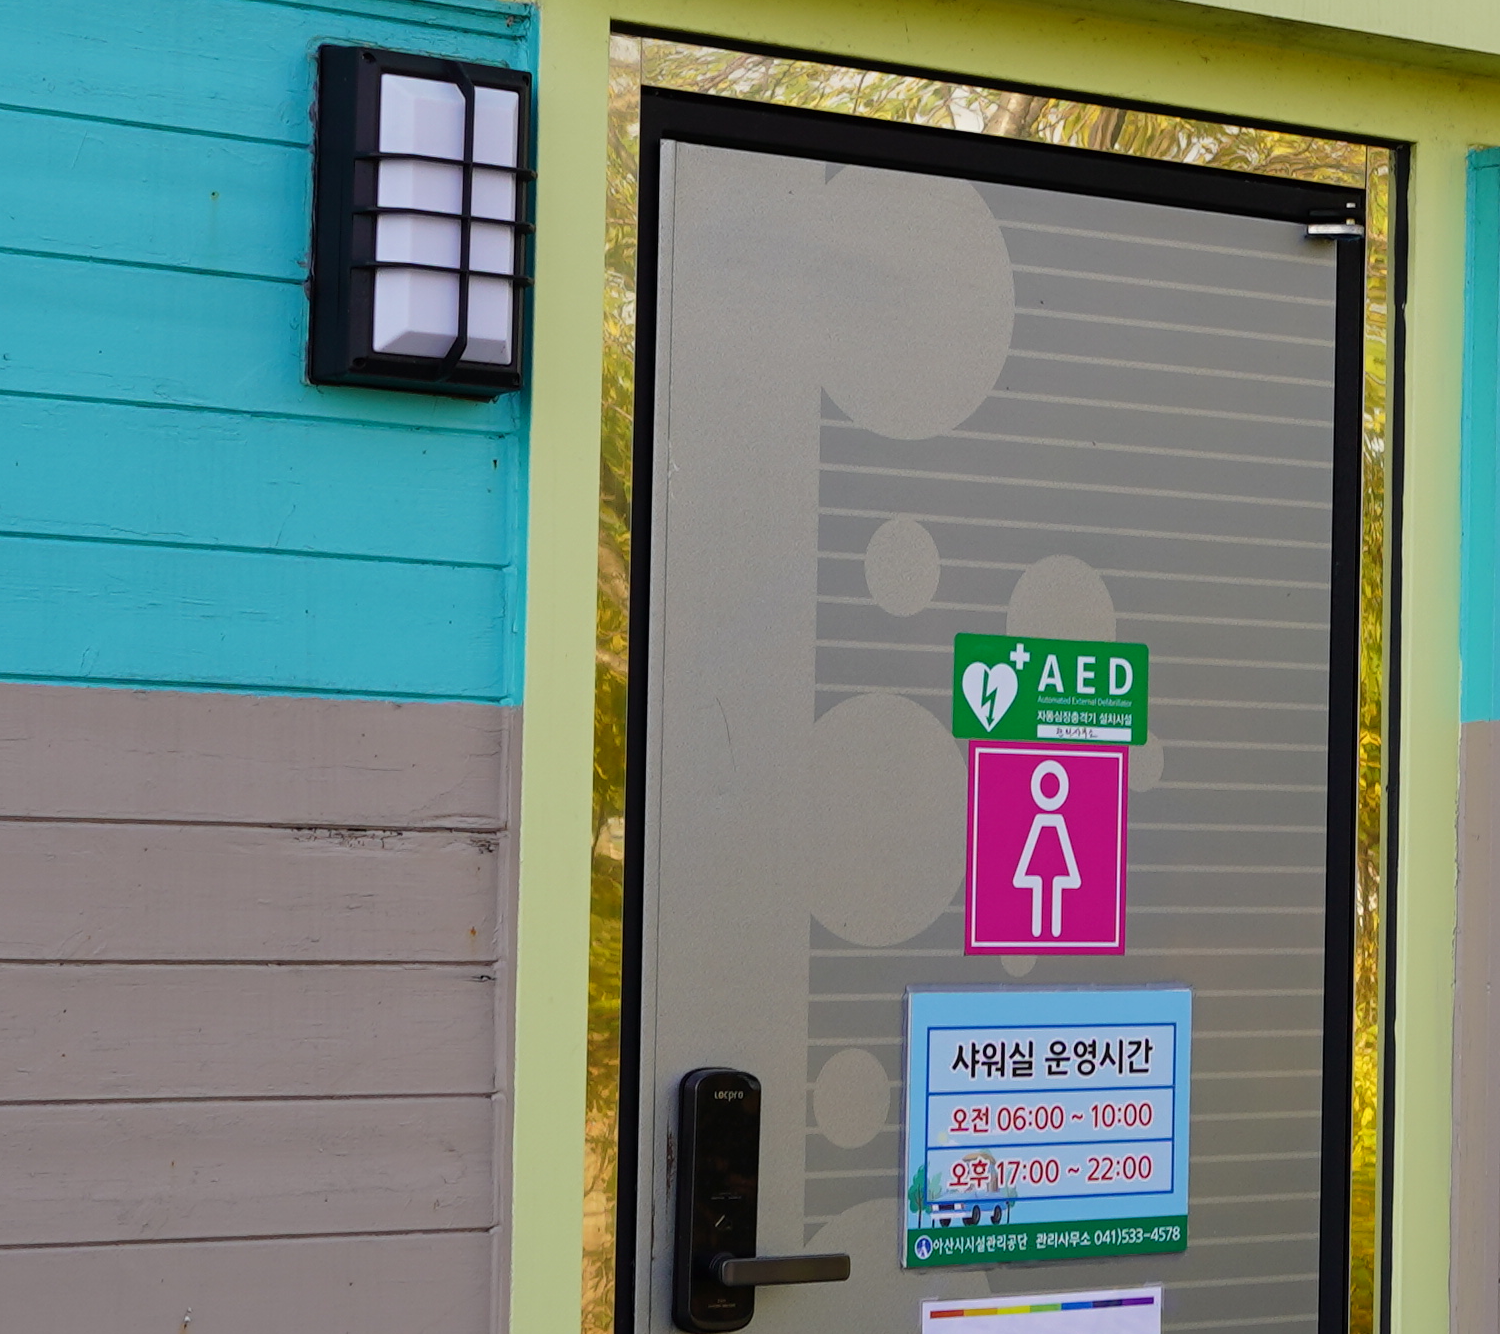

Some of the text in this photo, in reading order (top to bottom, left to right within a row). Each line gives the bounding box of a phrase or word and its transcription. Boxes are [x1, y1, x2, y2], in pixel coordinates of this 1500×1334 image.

[1037, 654, 1134, 696] AED
[952, 1038, 1154, 1079] 샤워실 운영시간
[950, 1106, 990, 1133] 오전
[997, 1105, 1064, 1131] 06:00
[1091, 1102, 1153, 1128] 10:00
[949, 1159, 989, 1187] 오후
[997, 1159, 1060, 1185] 17:00
[1087, 1155, 1153, 1181] 22:00
[933, 1226, 1181, 1255] 아산시시설관리공단 관리사무소 041)533-4578
